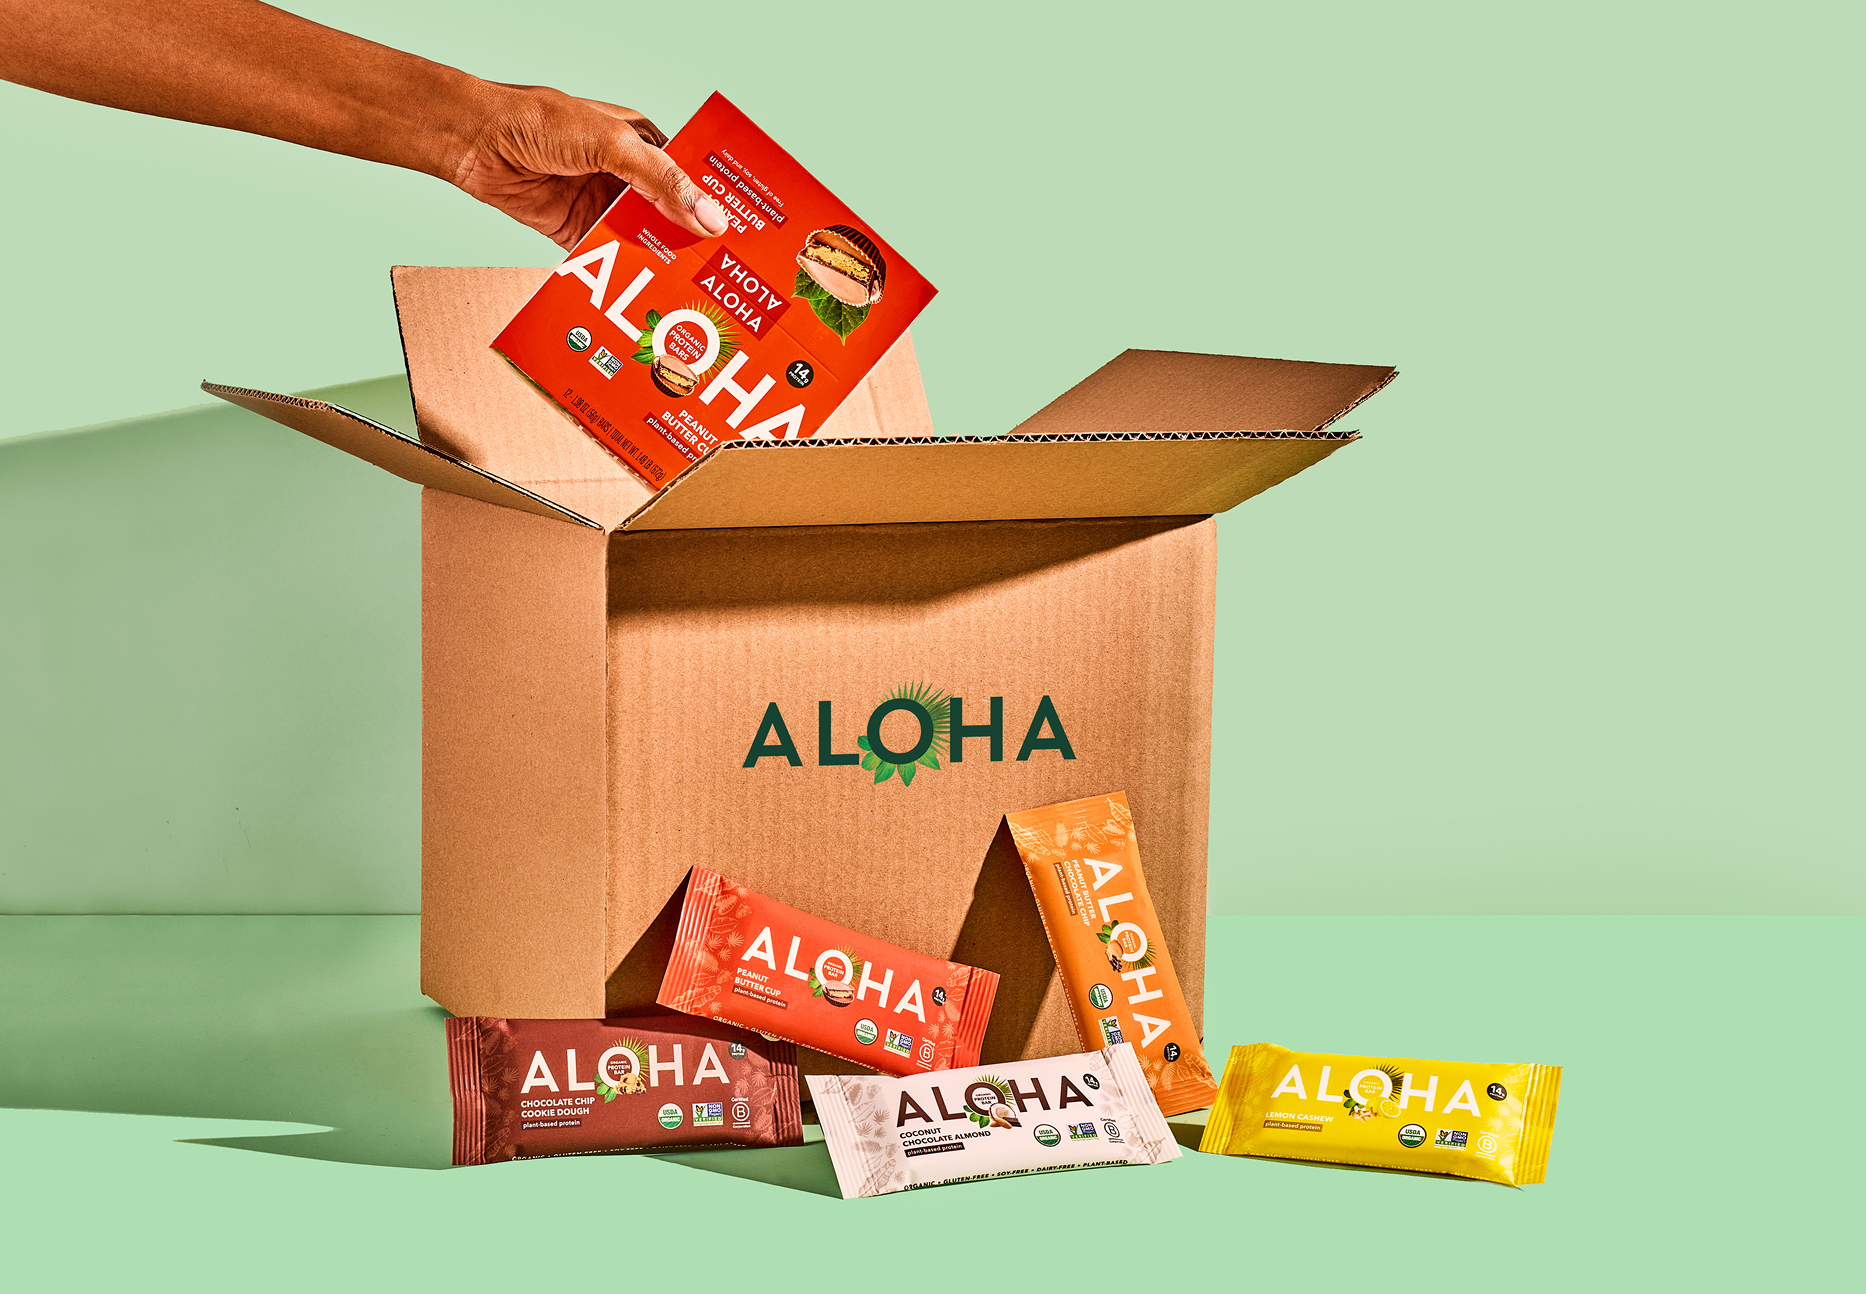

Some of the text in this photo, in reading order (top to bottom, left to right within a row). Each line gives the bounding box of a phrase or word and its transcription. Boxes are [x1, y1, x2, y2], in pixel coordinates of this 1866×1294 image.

[721, 149, 734, 162] dairy
[702, 175, 766, 231] BUTTER CUP
[709, 156, 785, 223] plant-based protein
[637, 233, 671, 265] INGREDIENTS
[642, 228, 677, 260] WHOLE FOOD
[721, 253, 782, 310] ALOHA
[700, 275, 762, 332] ALOHA
[556, 239, 806, 440] ALOHA
[576, 330, 588, 342] USDA
[669, 330, 701, 359] PROTEIN
[676, 325, 705, 351] ORGANIC
[669, 342, 689, 360] BARS
[788, 371, 804, 386] PROTEIN
[563, 388, 573, 398] 12
[571, 395, 584, 408] 1.98
[580, 402, 590, 413] OZ
[585, 407, 601, 424] (56g)
[597, 417, 612, 433] BARS
[610, 428, 623, 445] TOTAL
[620, 436, 632, 451] NET
[635, 452, 646, 465] 1.48
[643, 460, 653, 470] LB
[649, 464, 666, 481] (672g)
[646, 417, 689, 453] plant-based
[662, 411, 699, 445] BUTTER
[679, 410, 718, 444] PEANUT
[742, 695, 1076, 768] ALOHA
[1023, 862, 1036, 891] ORGANIC
[1055, 864, 1075, 914] plant-based protein
[1072, 859, 1096, 919] PEANUT BUTTER
[1064, 861, 1090, 926] CHOCOLATE CHIP
[1083, 858, 1171, 1049] ALOHA
[1125, 931, 1134, 952] PROTEIN
[737, 968, 769, 983] PEANUT
[741, 926, 926, 1023] ALOHA
[824, 964, 844, 975] PROTEIN
[734, 977, 781, 996] BUTTER CUP
[734, 987, 786, 1008] plant-based protein
[1100, 989, 1108, 1003] USDA
[713, 1016, 744, 1028] ORGANIC
[860, 1024, 874, 1032] USDA
[520, 1043, 730, 1094] ALOHA
[521, 1097, 595, 1108] CHOCOLATE CHIP
[897, 1076, 1094, 1127] ALOHA
[1271, 1064, 1481, 1117] ALOHA
[521, 1108, 589, 1118] COOKIE DOUGH
[523, 1120, 557, 1129] plant-based
[1264, 1121, 1298, 1129] plant-based
[1298, 1114, 1334, 1122] CASHEW
[900, 1128, 941, 1139] COCONUT
[903, 1131, 991, 1147] CHOCOLATE ALMOND
[907, 1147, 941, 1156] plant-based
[904, 1159, 1128, 1190] ORGANIC GLUTEN-FREE SOY-FREE DAIRY-FREE PLANT-BASED
